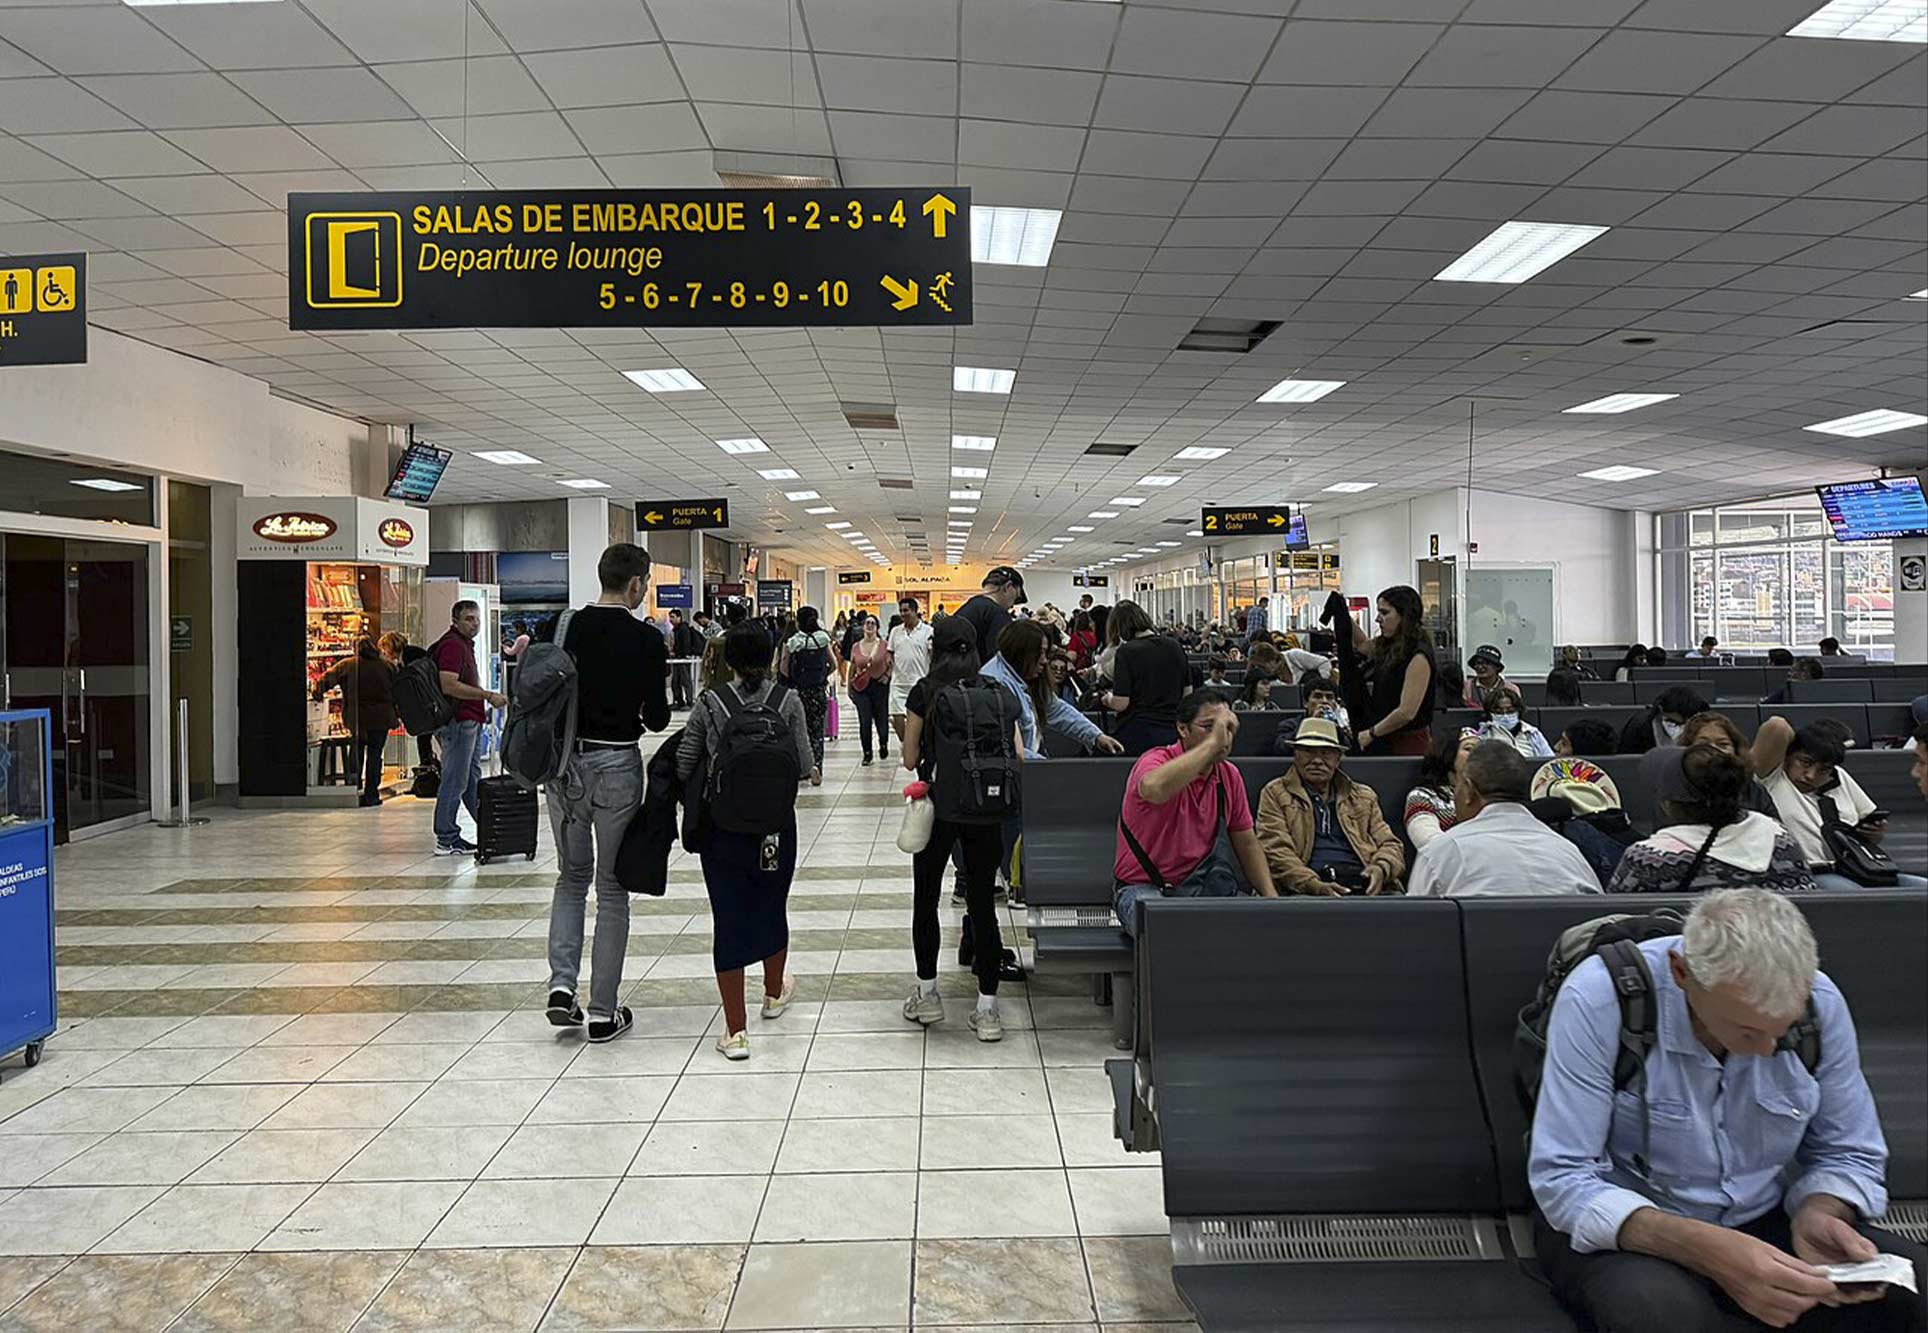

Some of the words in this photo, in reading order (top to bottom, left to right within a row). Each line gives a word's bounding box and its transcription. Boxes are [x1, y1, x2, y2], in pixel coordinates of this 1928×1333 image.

[413, 204, 514, 235] SALAS
[523, 204, 563, 234] DE
[573, 201, 746, 234] EMBARQUE
[763, 202, 775, 231] 1
[804, 201, 821, 230] 2
[847, 200, 864, 230] 3
[889, 199, 907, 229] 4
[417, 242, 559, 278] Departure
[567, 241, 663, 276] lounge
[600, 282, 617, 310] 5
[643, 282, 660, 310] 6
[686, 282, 702, 309] 7
[730, 281, 746, 309] 8
[773, 281, 790, 308] 9
[817, 280, 849, 308] 10
[672, 508, 707, 516] PUERTA
[712, 507, 722, 523] 1
[1225, 512, 1259, 521] PUERTA
[672, 517, 692, 526] Gate
[1205, 515, 1218, 530] 2
